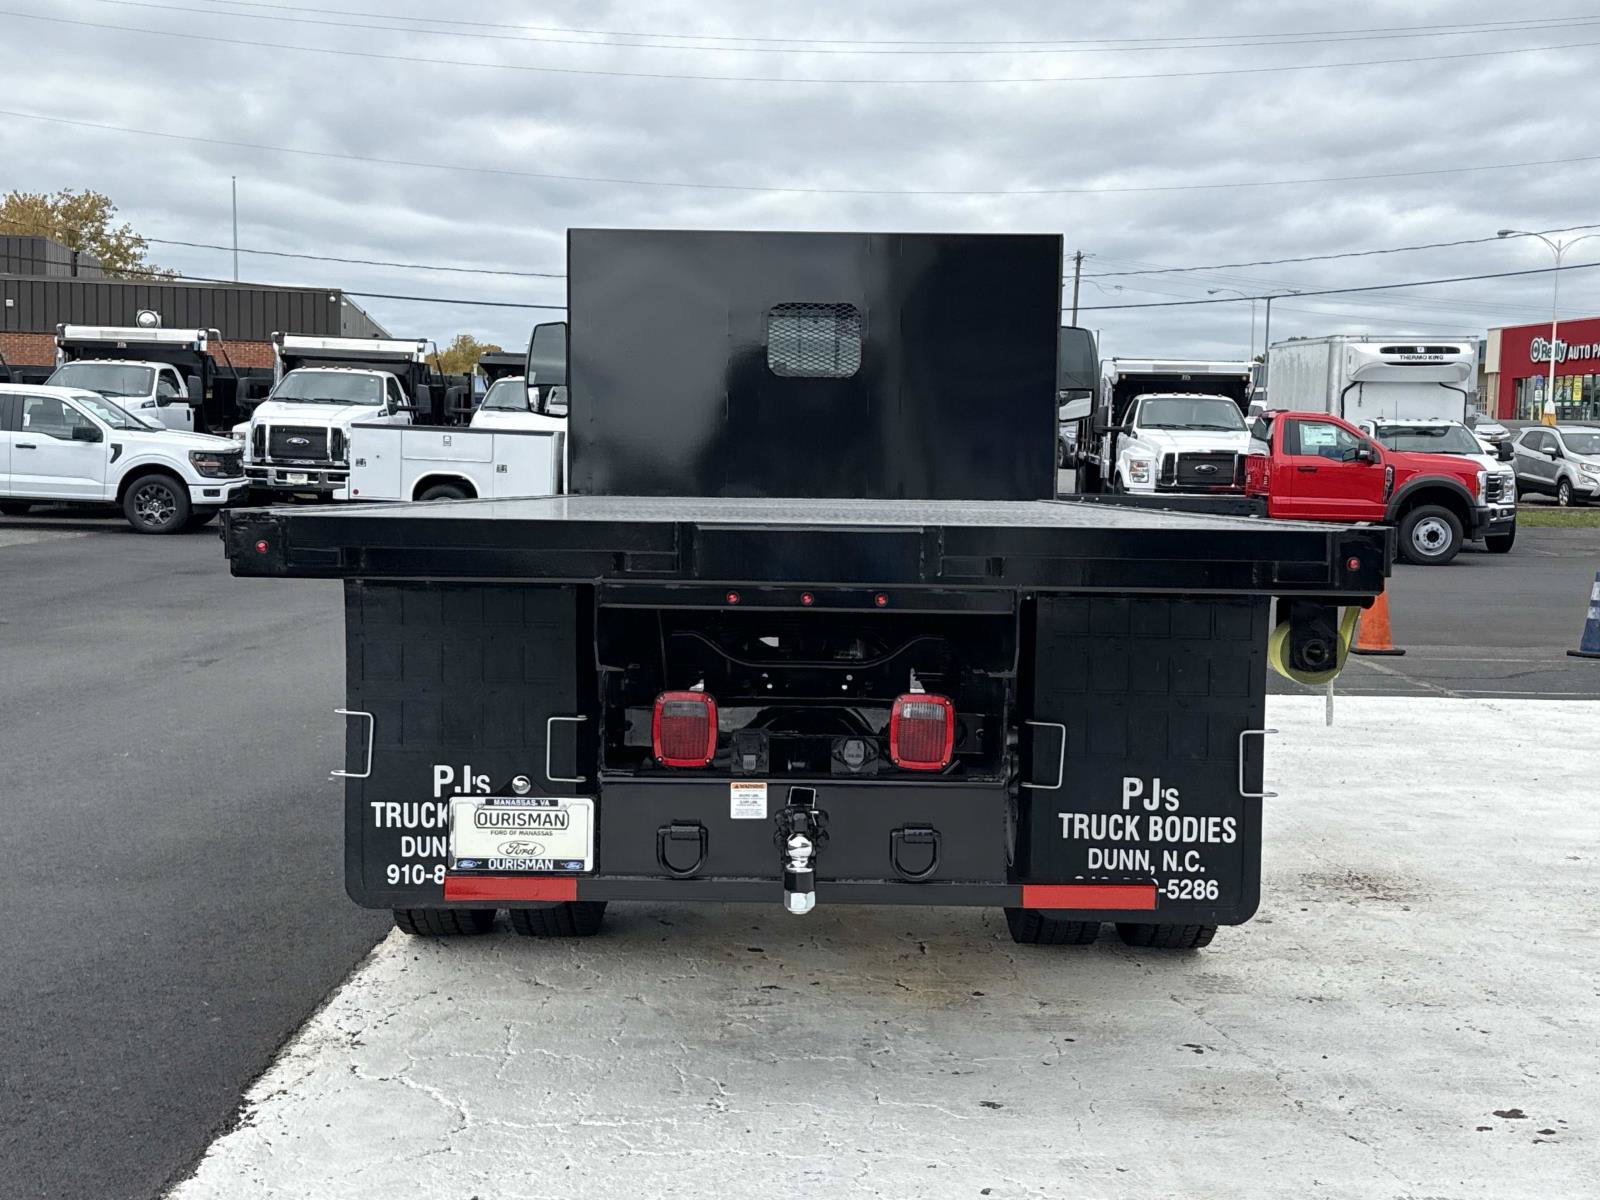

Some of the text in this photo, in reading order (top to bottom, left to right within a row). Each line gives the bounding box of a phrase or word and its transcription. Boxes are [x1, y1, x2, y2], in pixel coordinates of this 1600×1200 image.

[1531, 338, 1567, 363] O'Relly
[1568, 345, 1590, 360] AUTO
[477, 812, 566, 827] OURISMAN
[1058, 813, 1237, 844] TRUCK BODIES
[504, 840, 538, 856] Ford
[487, 859, 554, 870] OURISMAN
[1088, 848, 1206, 875] DUNN, N.C.
